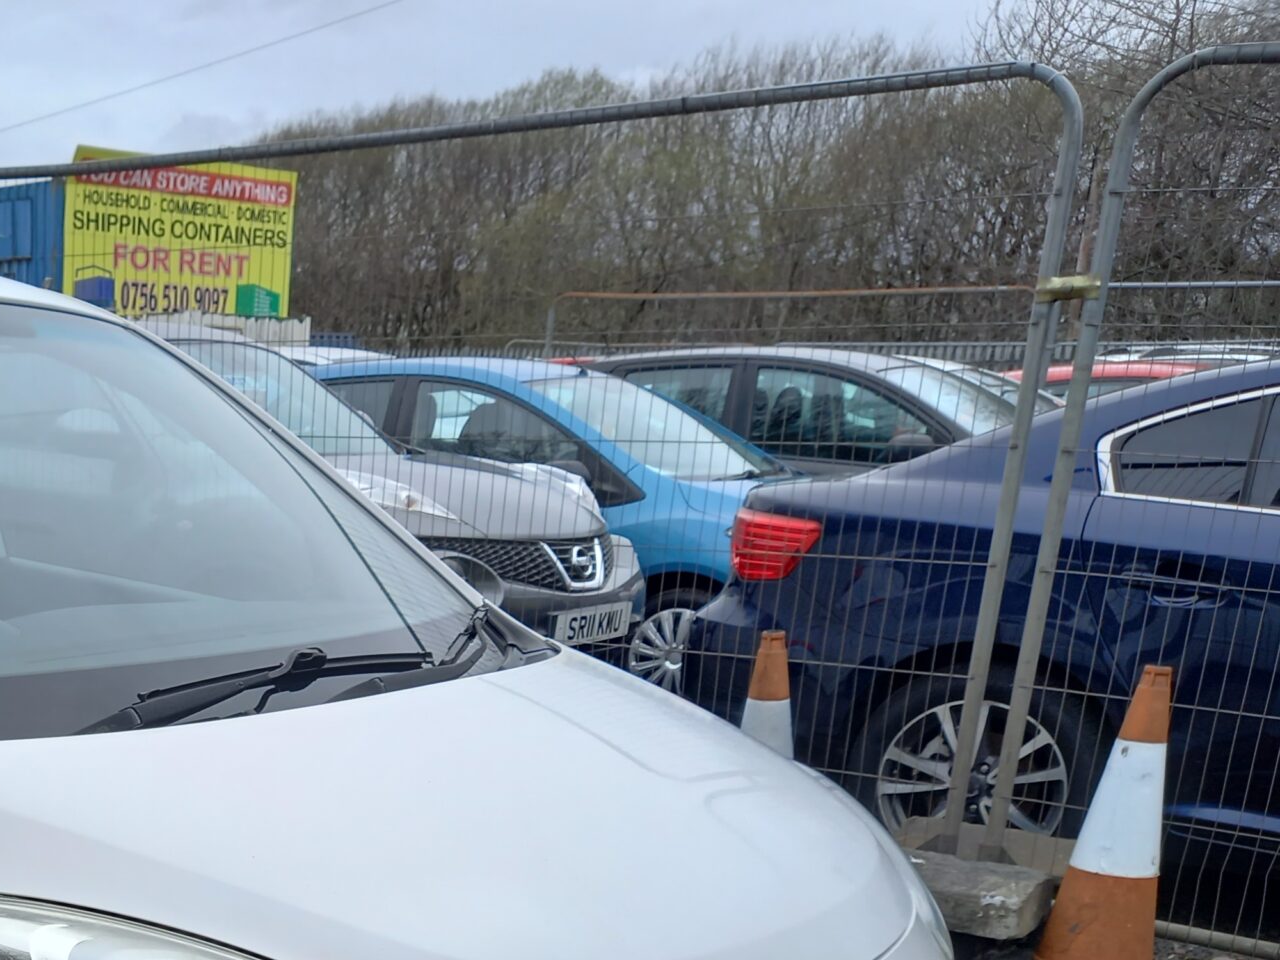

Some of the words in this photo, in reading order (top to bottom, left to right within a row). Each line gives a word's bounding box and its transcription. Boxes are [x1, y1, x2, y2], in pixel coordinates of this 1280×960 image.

[120, 168, 152, 188] CAN
[156, 171, 209, 193] STORE
[212, 178, 287, 203] ANYTHING
[83, 188, 150, 210] HOUSEHOLD
[160, 198, 228, 219] COMMERCIAL
[236, 206, 286, 225] DOMESTIC
[73, 210, 165, 238] SHIPPING
[171, 219, 287, 248] CONTAINERS
[114, 243, 170, 272] FOR
[179, 249, 249, 277] RENT
[121, 281, 157, 311] 0756
[163, 284, 189, 312] 510
[194, 286, 228, 313] 9097
[567, 614, 596, 640] SR11
